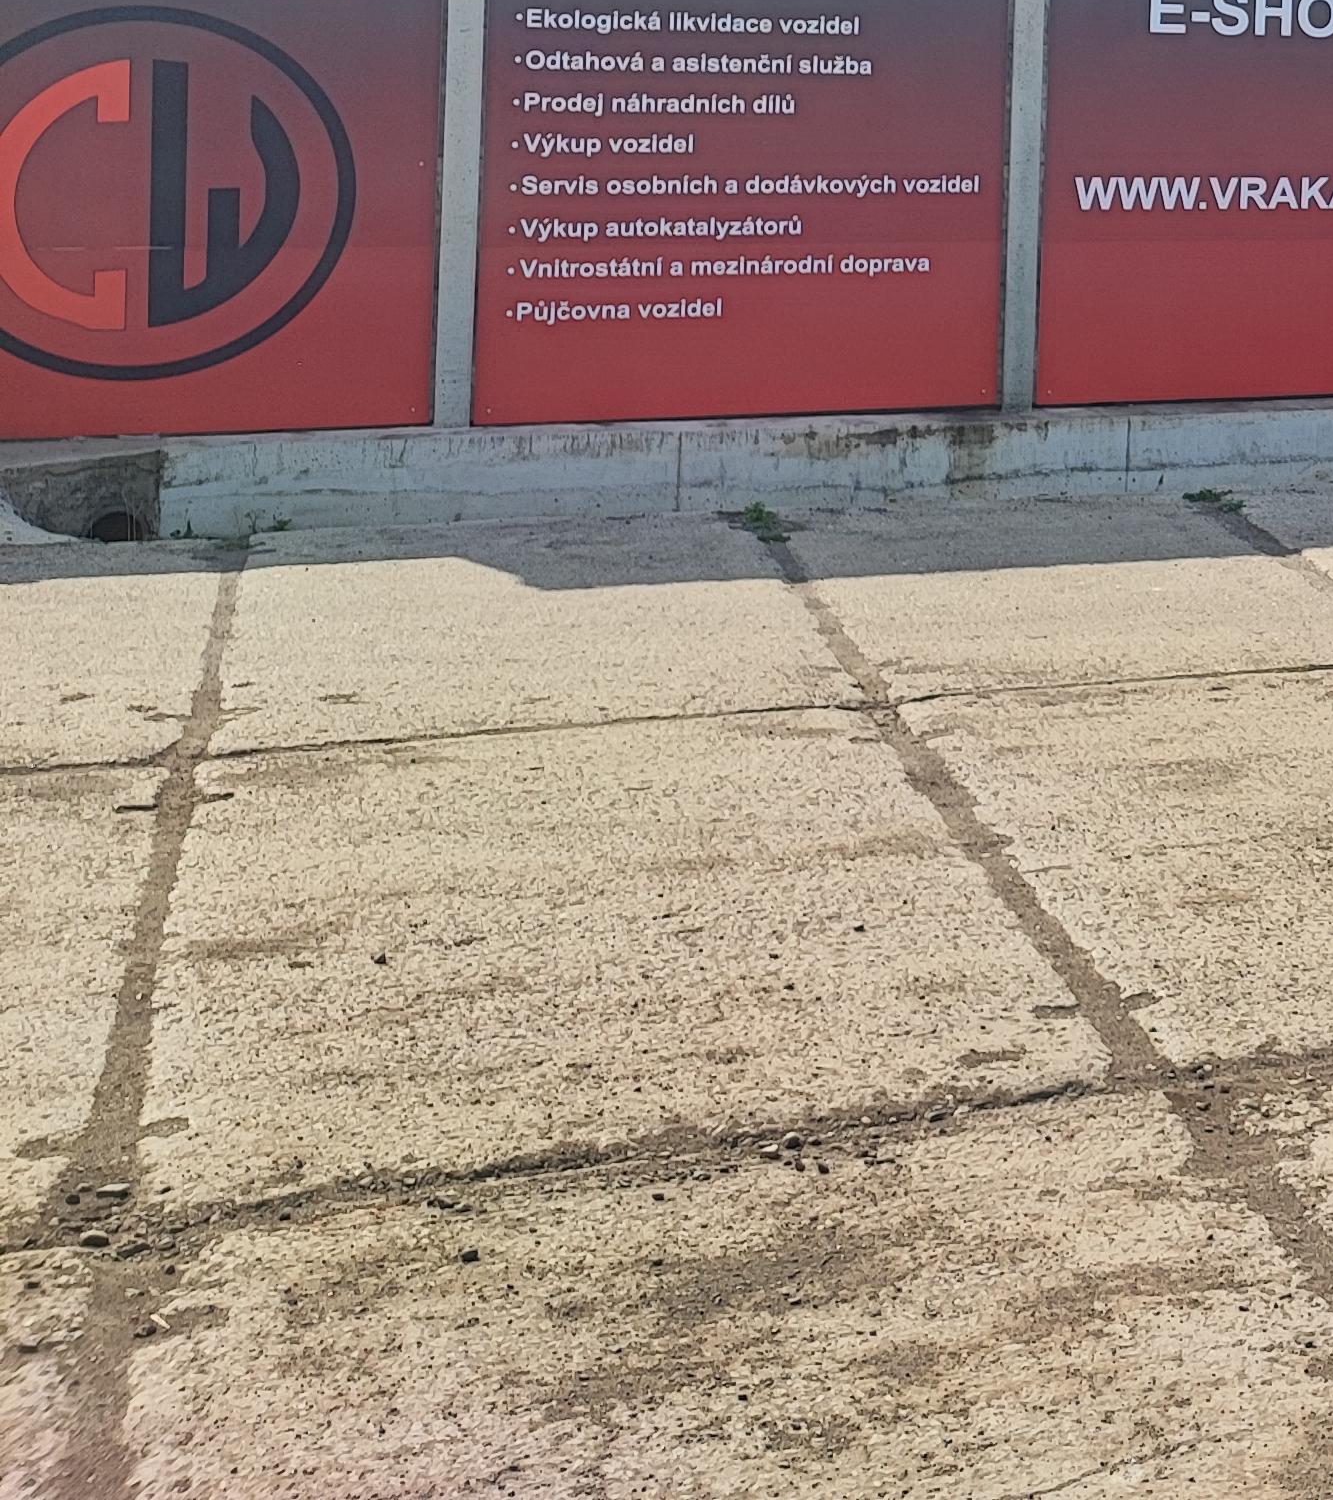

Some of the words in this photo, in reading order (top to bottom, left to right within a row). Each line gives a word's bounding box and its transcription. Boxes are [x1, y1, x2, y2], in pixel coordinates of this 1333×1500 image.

[526, 8, 661, 34] Ekologická
[669, 11, 773, 34] likvidace
[779, 14, 860, 35] vozidel
[525, 50, 644, 73] Odtahová
[651, 56, 665, 73] a
[672, 53, 793, 74] asistenční
[798, 55, 872, 75] služba
[523, 92, 604, 117] Prodej
[611, 93, 746, 115] náhradních
[752, 93, 795, 115] dílů
[523, 133, 602, 158] Výkup
[608, 134, 694, 154] vozidel
[521, 175, 599, 195] Servis
[606, 174, 718, 195] osobních
[724, 179, 738, 195] a
[745, 174, 897, 198] dodávkových
[902, 174, 980, 194] vozidel
[520, 218, 599, 243] Výkup
[605, 215, 802, 240] autokatalyzátorů
[519, 258, 663, 278] Vnitrostátní
[669, 261, 683, 277] a
[690, 254, 834, 276] mezinárodní
[840, 255, 931, 277] doprava
[516, 300, 630, 326] Půjčovna
[637, 298, 722, 319] vozidel
